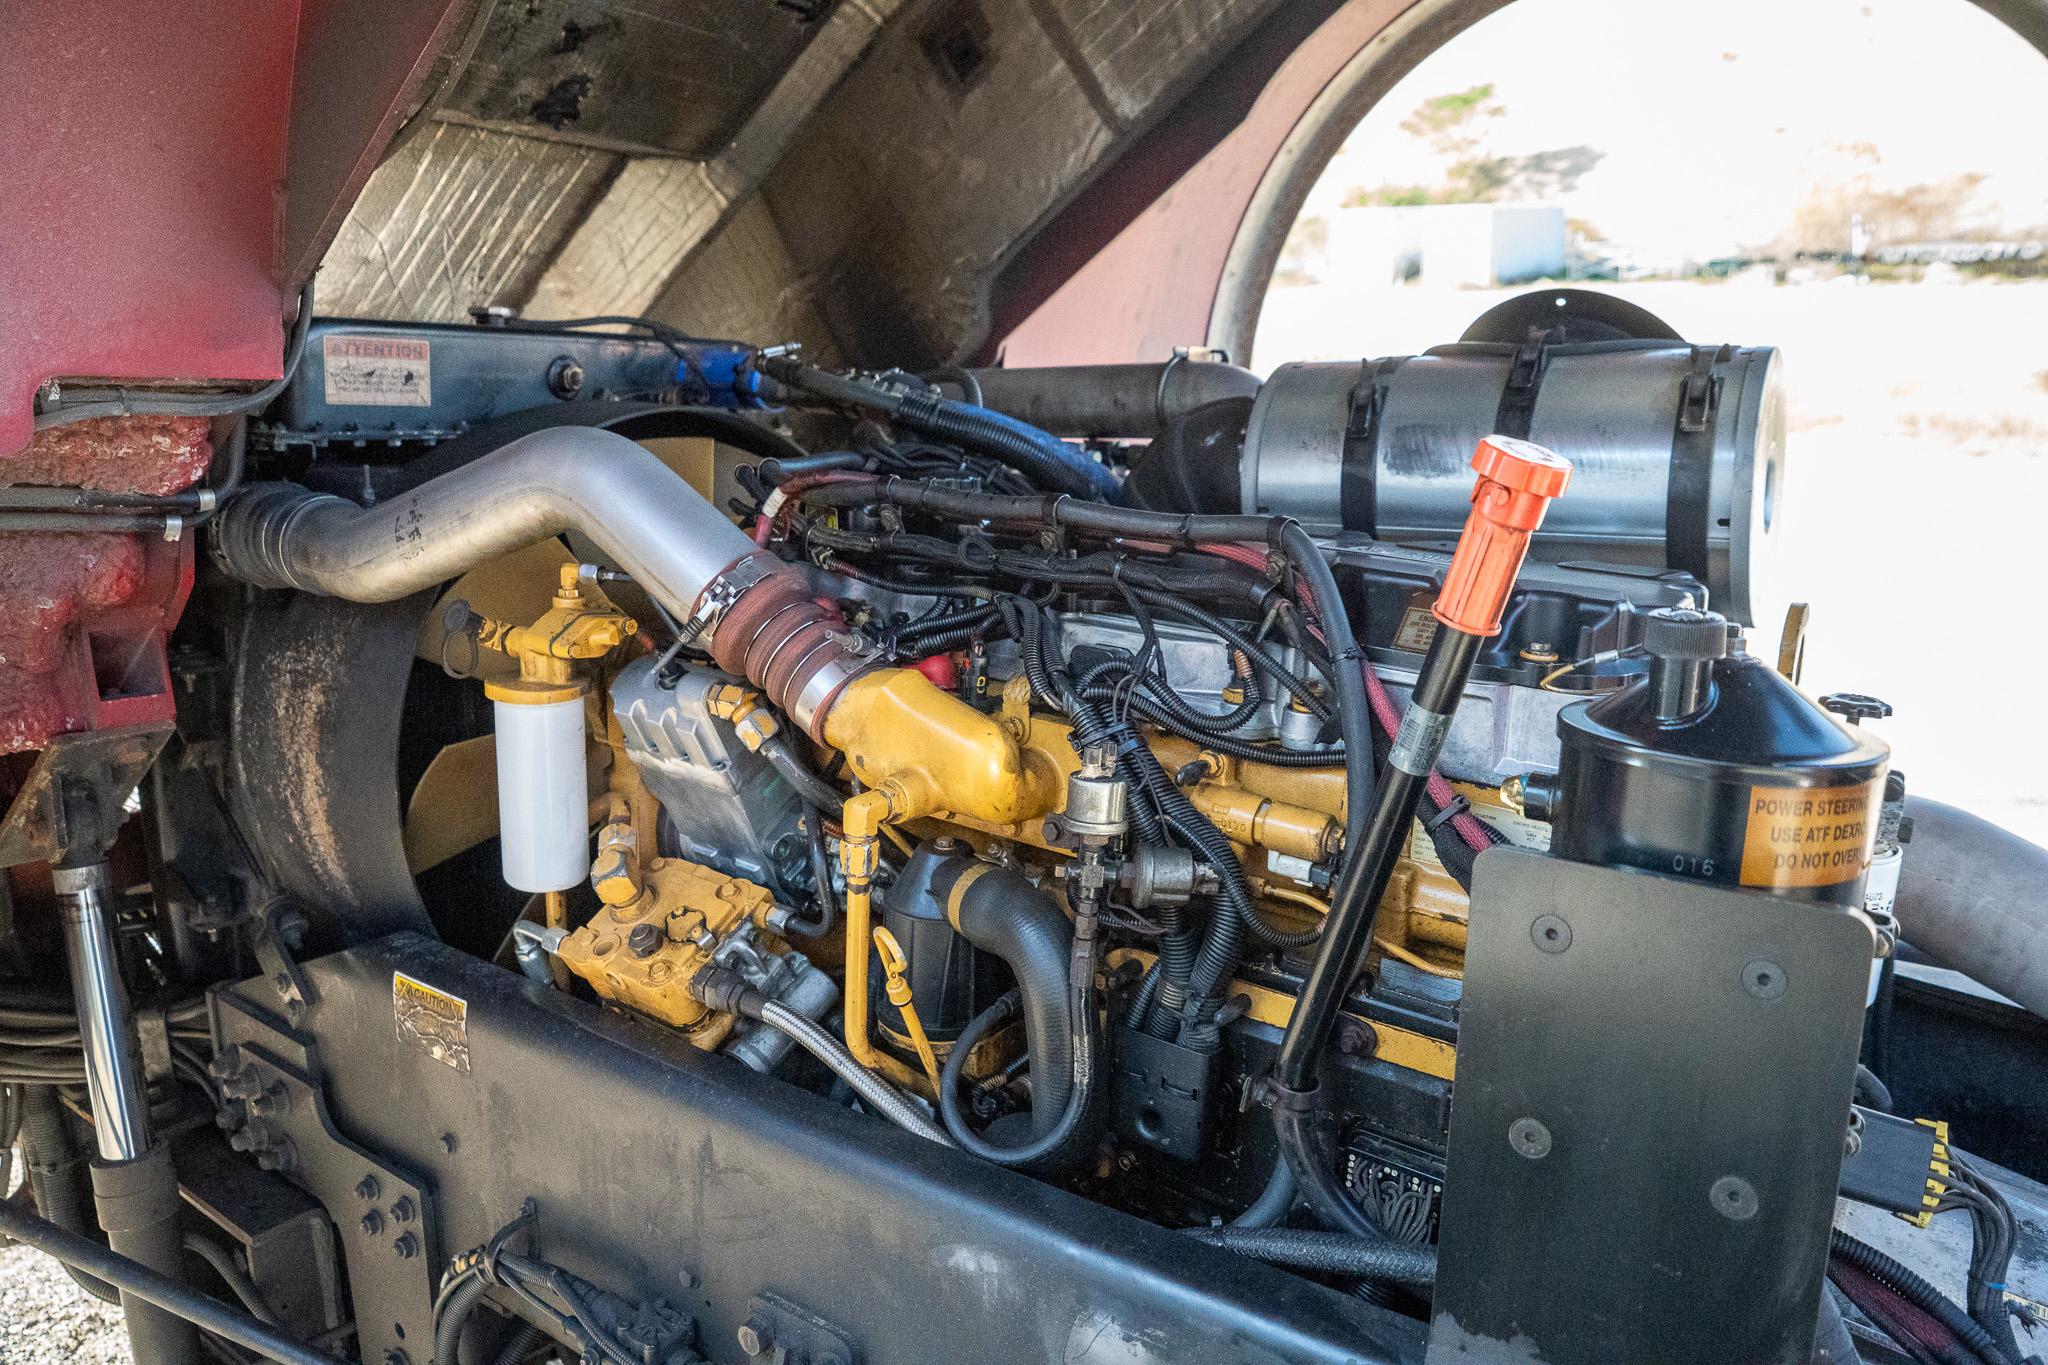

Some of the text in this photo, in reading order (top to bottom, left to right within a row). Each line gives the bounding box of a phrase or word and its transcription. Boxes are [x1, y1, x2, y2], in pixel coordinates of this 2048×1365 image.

[331, 343, 424, 359] ATTENTION
[1755, 799, 1813, 817] POWER
[1771, 826, 1801, 843] USE
[1806, 826, 1831, 843] ATF
[1673, 855, 1714, 876] 016
[1774, 853, 1797, 869] DO
[1801, 852, 1830, 869] NOT
[414, 988, 452, 1012] CAUTION
